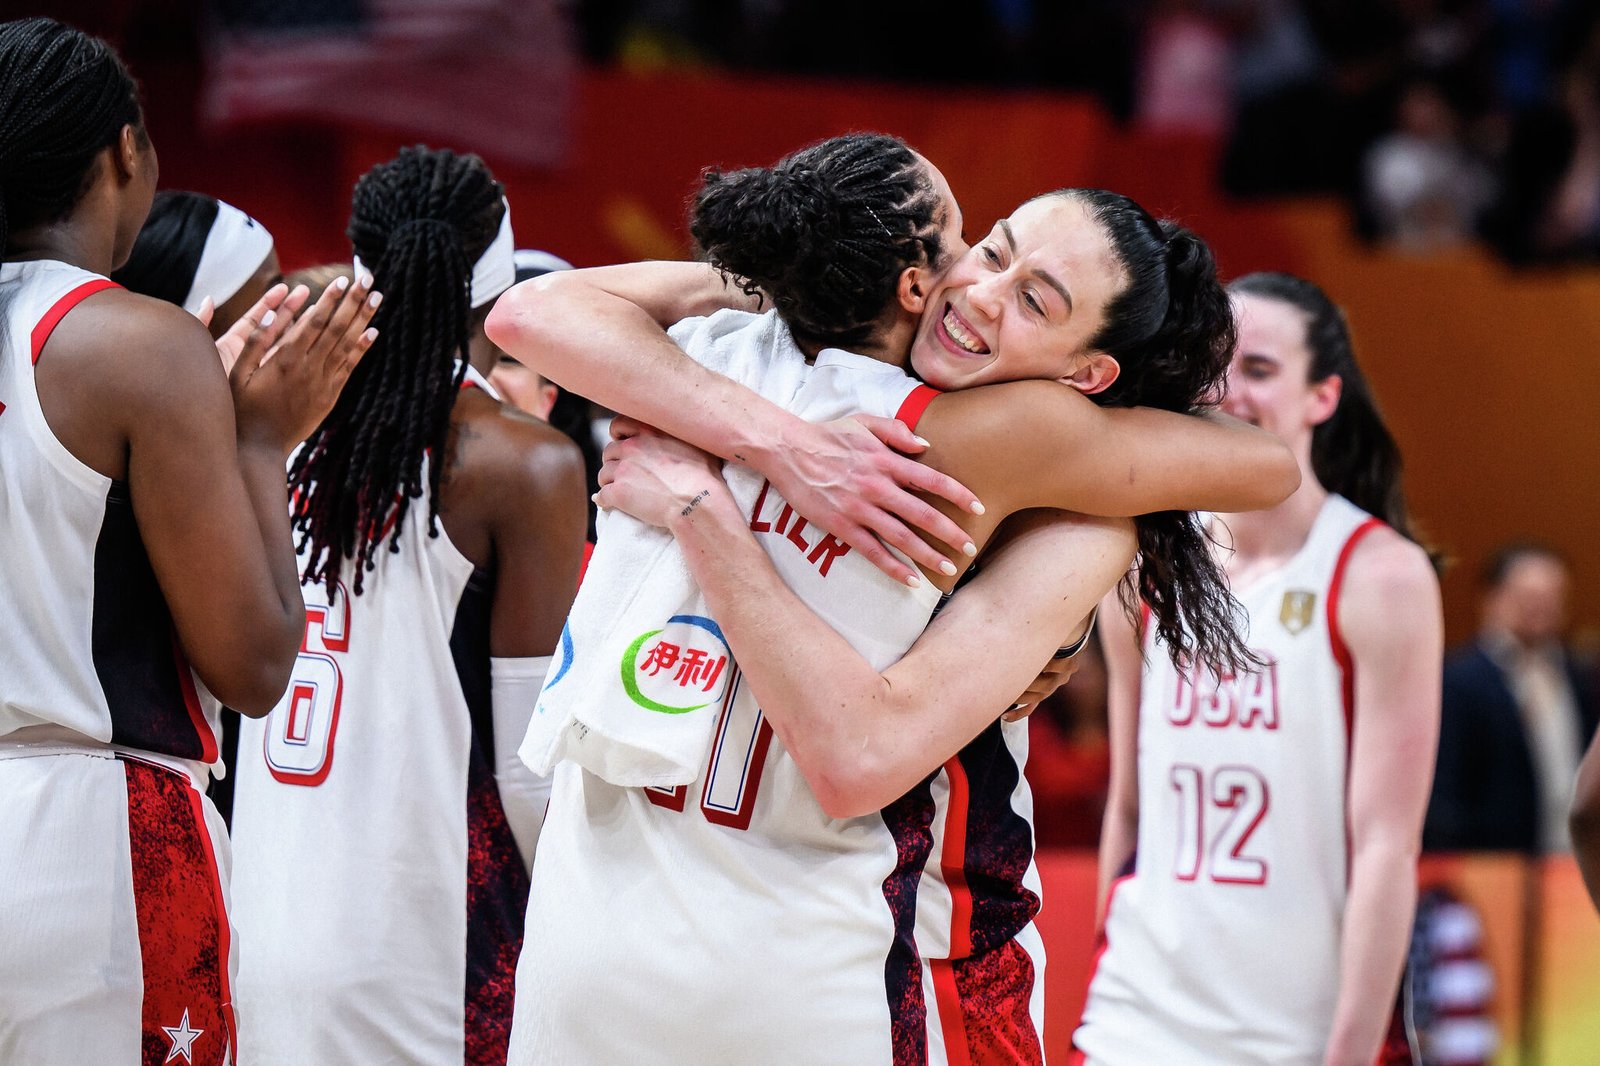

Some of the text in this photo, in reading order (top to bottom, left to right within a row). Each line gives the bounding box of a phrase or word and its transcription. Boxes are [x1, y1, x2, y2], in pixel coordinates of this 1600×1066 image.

[264, 574, 351, 787] 6
[640, 641, 727, 692] 伊利
[1166, 650, 1279, 729] USA
[643, 663, 774, 831] 1
[1171, 765, 1268, 885] 12
